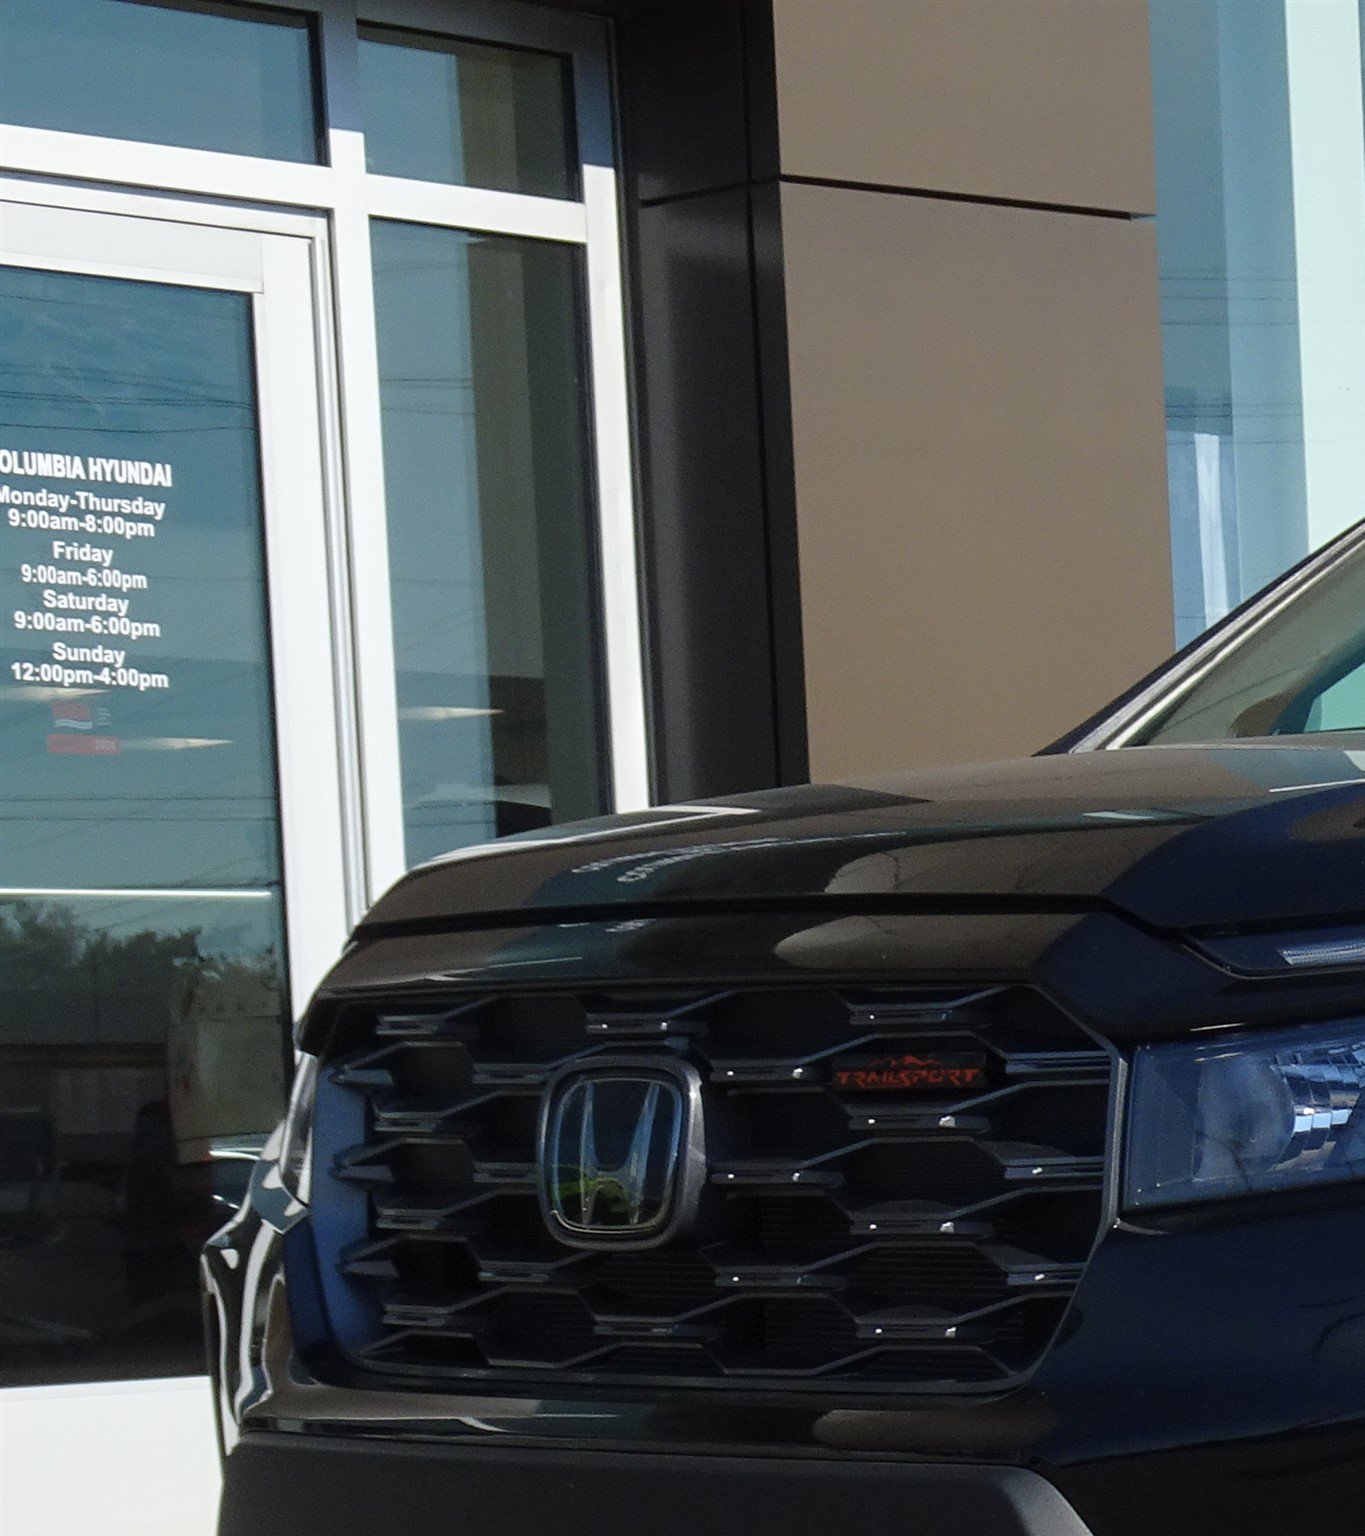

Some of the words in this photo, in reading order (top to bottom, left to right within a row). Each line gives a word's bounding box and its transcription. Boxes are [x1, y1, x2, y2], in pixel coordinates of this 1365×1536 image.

[0, 449, 86, 479] OLUMBIA
[89, 456, 173, 487] HYUNDAI
[8, 507, 155, 539] 9:00am-8:00pm
[53, 541, 114, 567] Friday
[21, 564, 148, 592] 9:00am-6:00pm
[43, 589, 130, 616] Saturday
[14, 610, 161, 640] 9:00am-6:00pm
[53, 642, 126, 667] Sunday
[11, 662, 169, 691] 12:00pm-4:00pm
